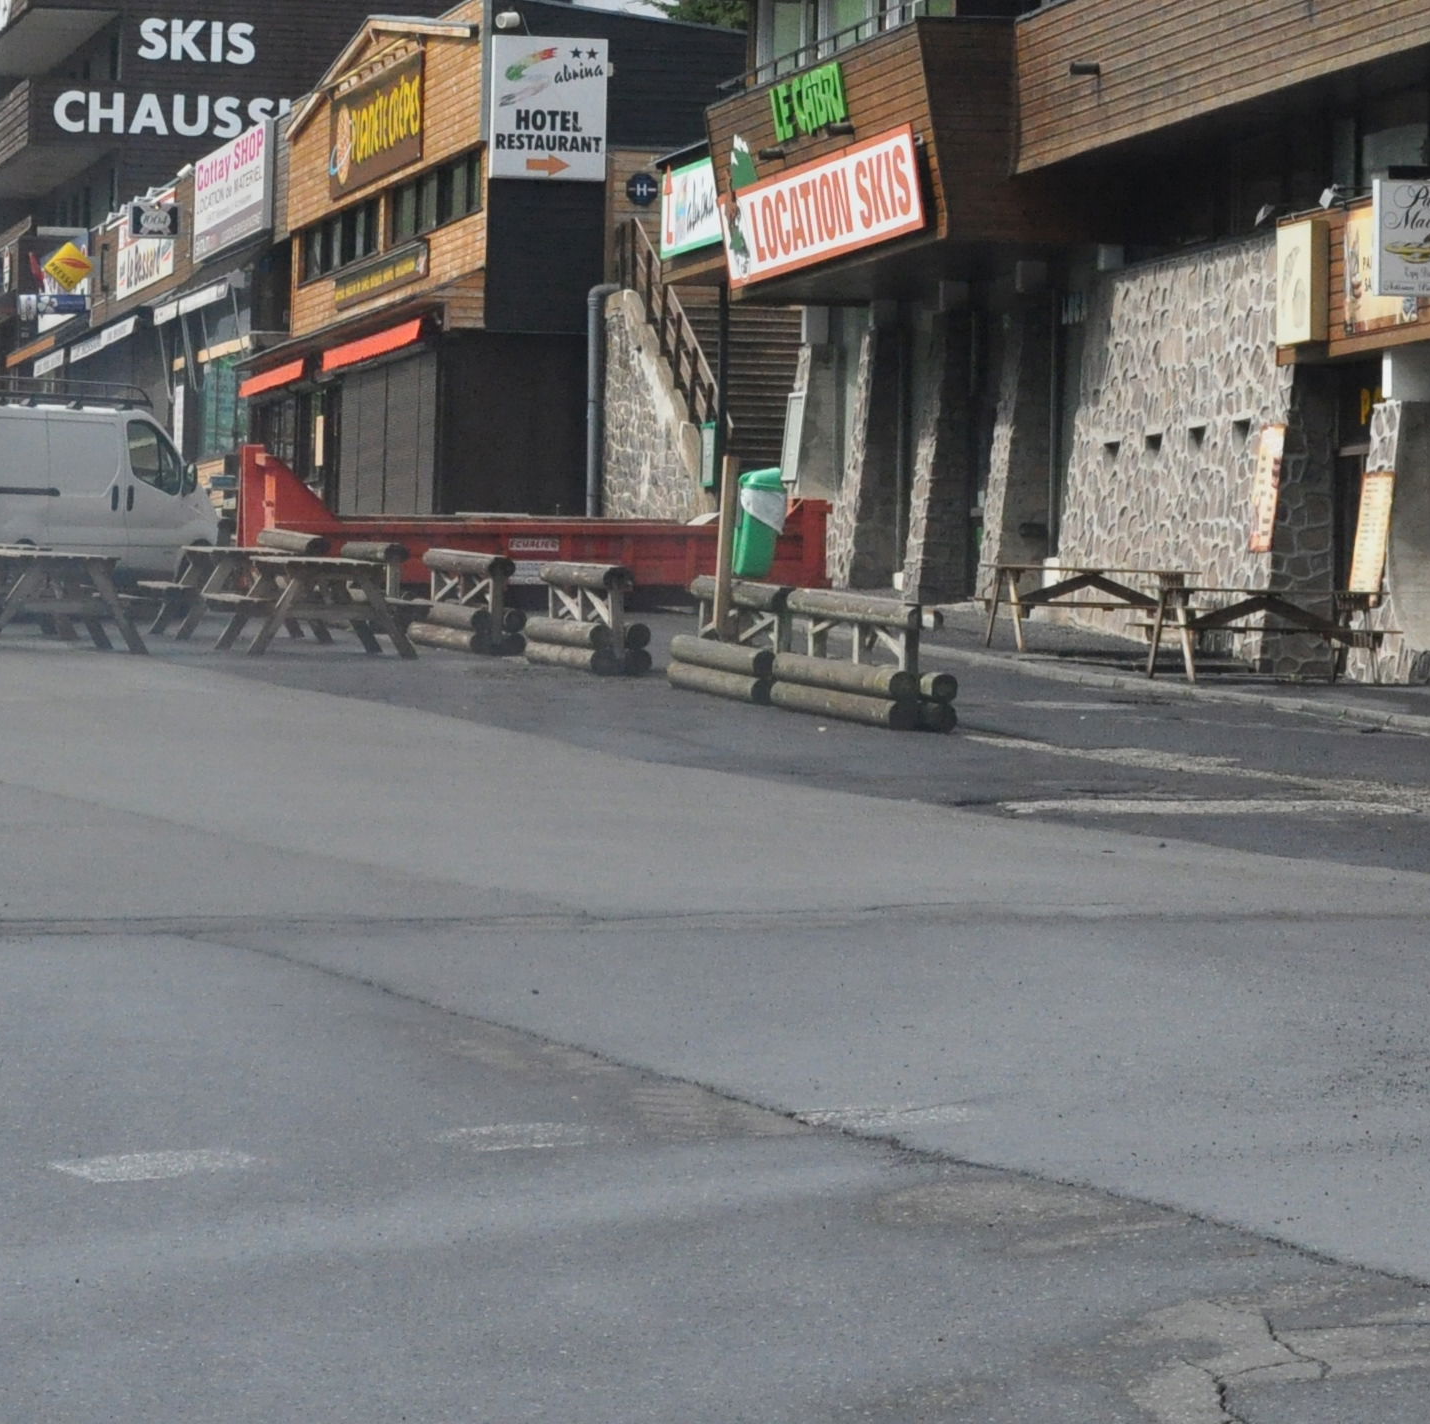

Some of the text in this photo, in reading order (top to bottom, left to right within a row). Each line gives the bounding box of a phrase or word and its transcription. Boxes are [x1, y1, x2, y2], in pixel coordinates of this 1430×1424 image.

[137, 18, 256, 64] SKIS
[516, 109, 582, 132] HOTEL
[769, 62, 845, 143] LE CABRI
[233, 127, 265, 171] SHOP
[495, 133, 602, 153] RESTAURANT
[749, 144, 911, 264] LOCATION SKIS
